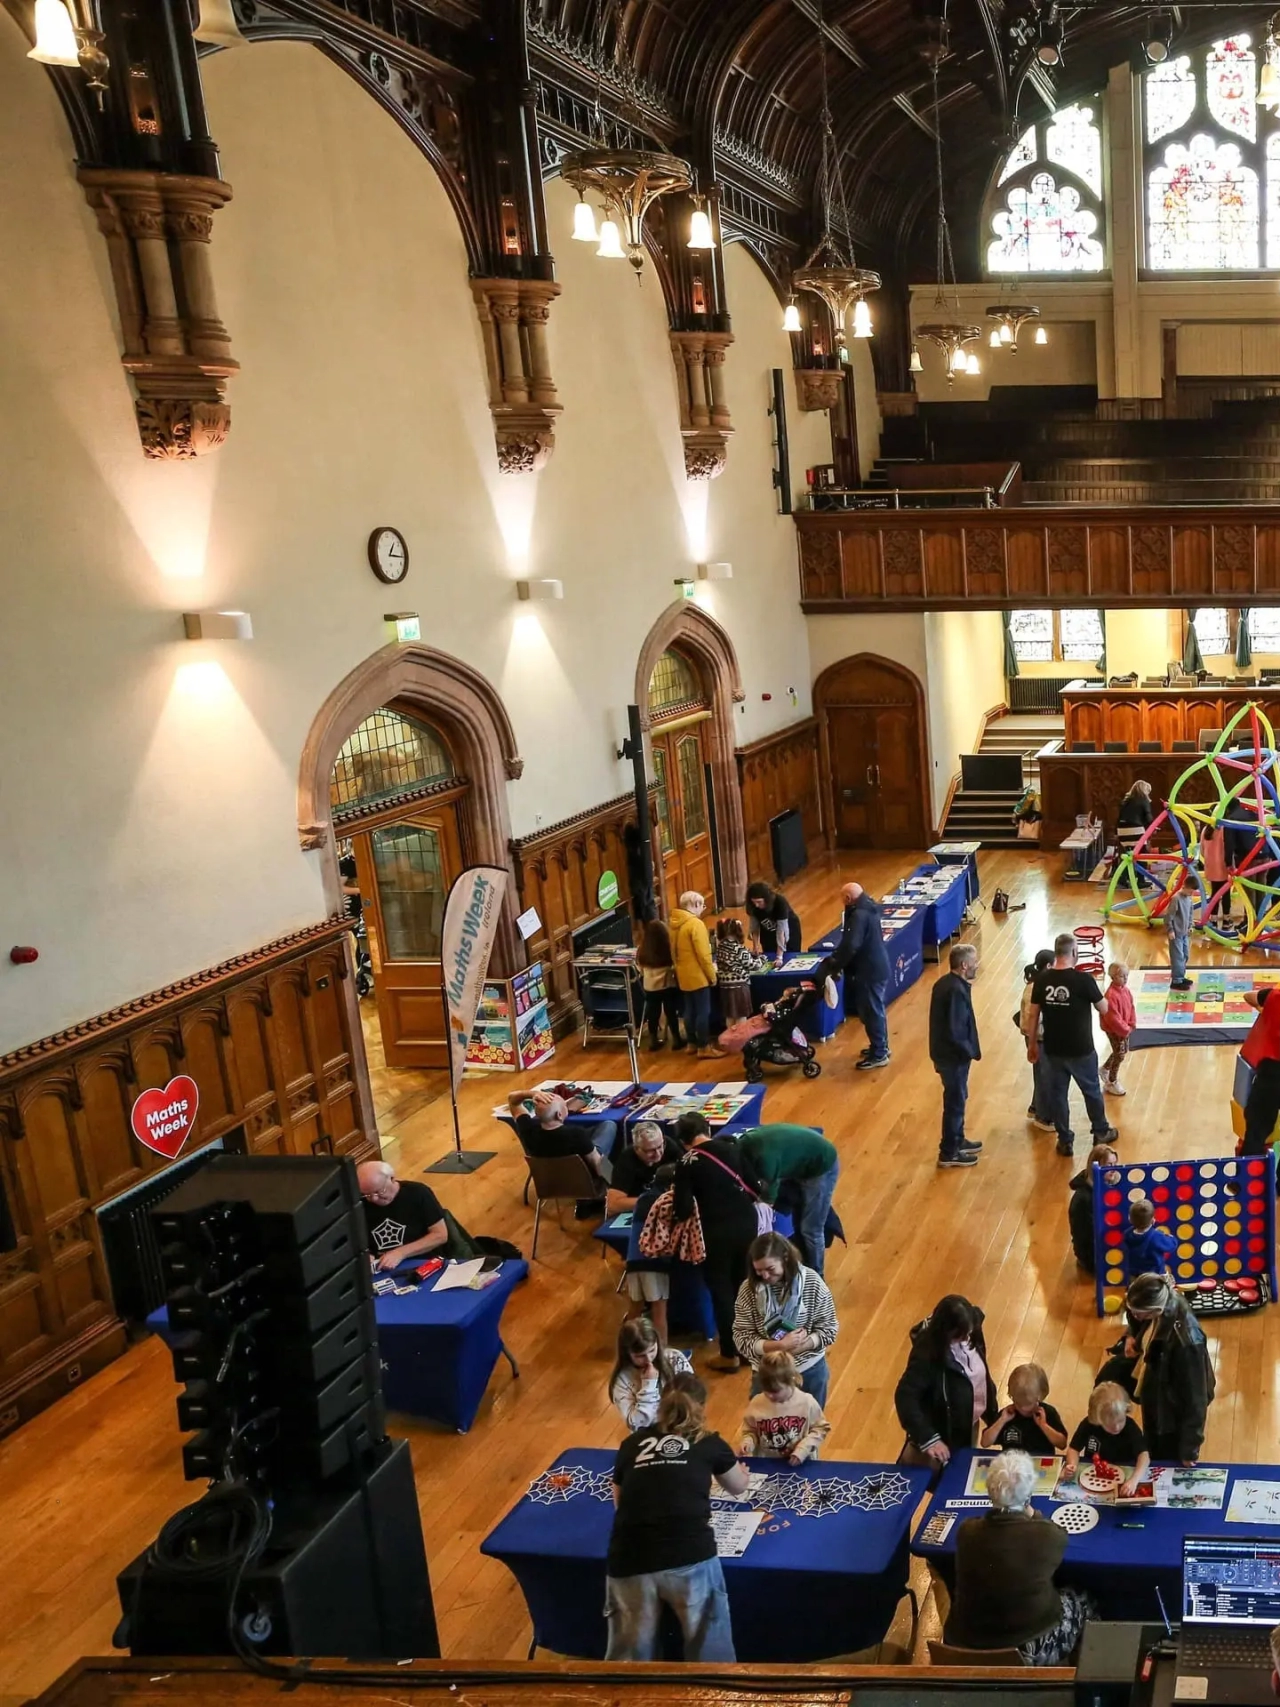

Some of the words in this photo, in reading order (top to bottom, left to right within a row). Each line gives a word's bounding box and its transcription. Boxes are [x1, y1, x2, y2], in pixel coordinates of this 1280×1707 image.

[448, 937, 473, 1007] Maths
[462, 875, 489, 938] Week
[146, 1099, 189, 1128] Maths
[150, 1114, 189, 1141] Week
[757, 1416, 806, 1435] MICKEY
[635, 1434, 691, 1463] 20
[756, 1519, 791, 1535] FOR
